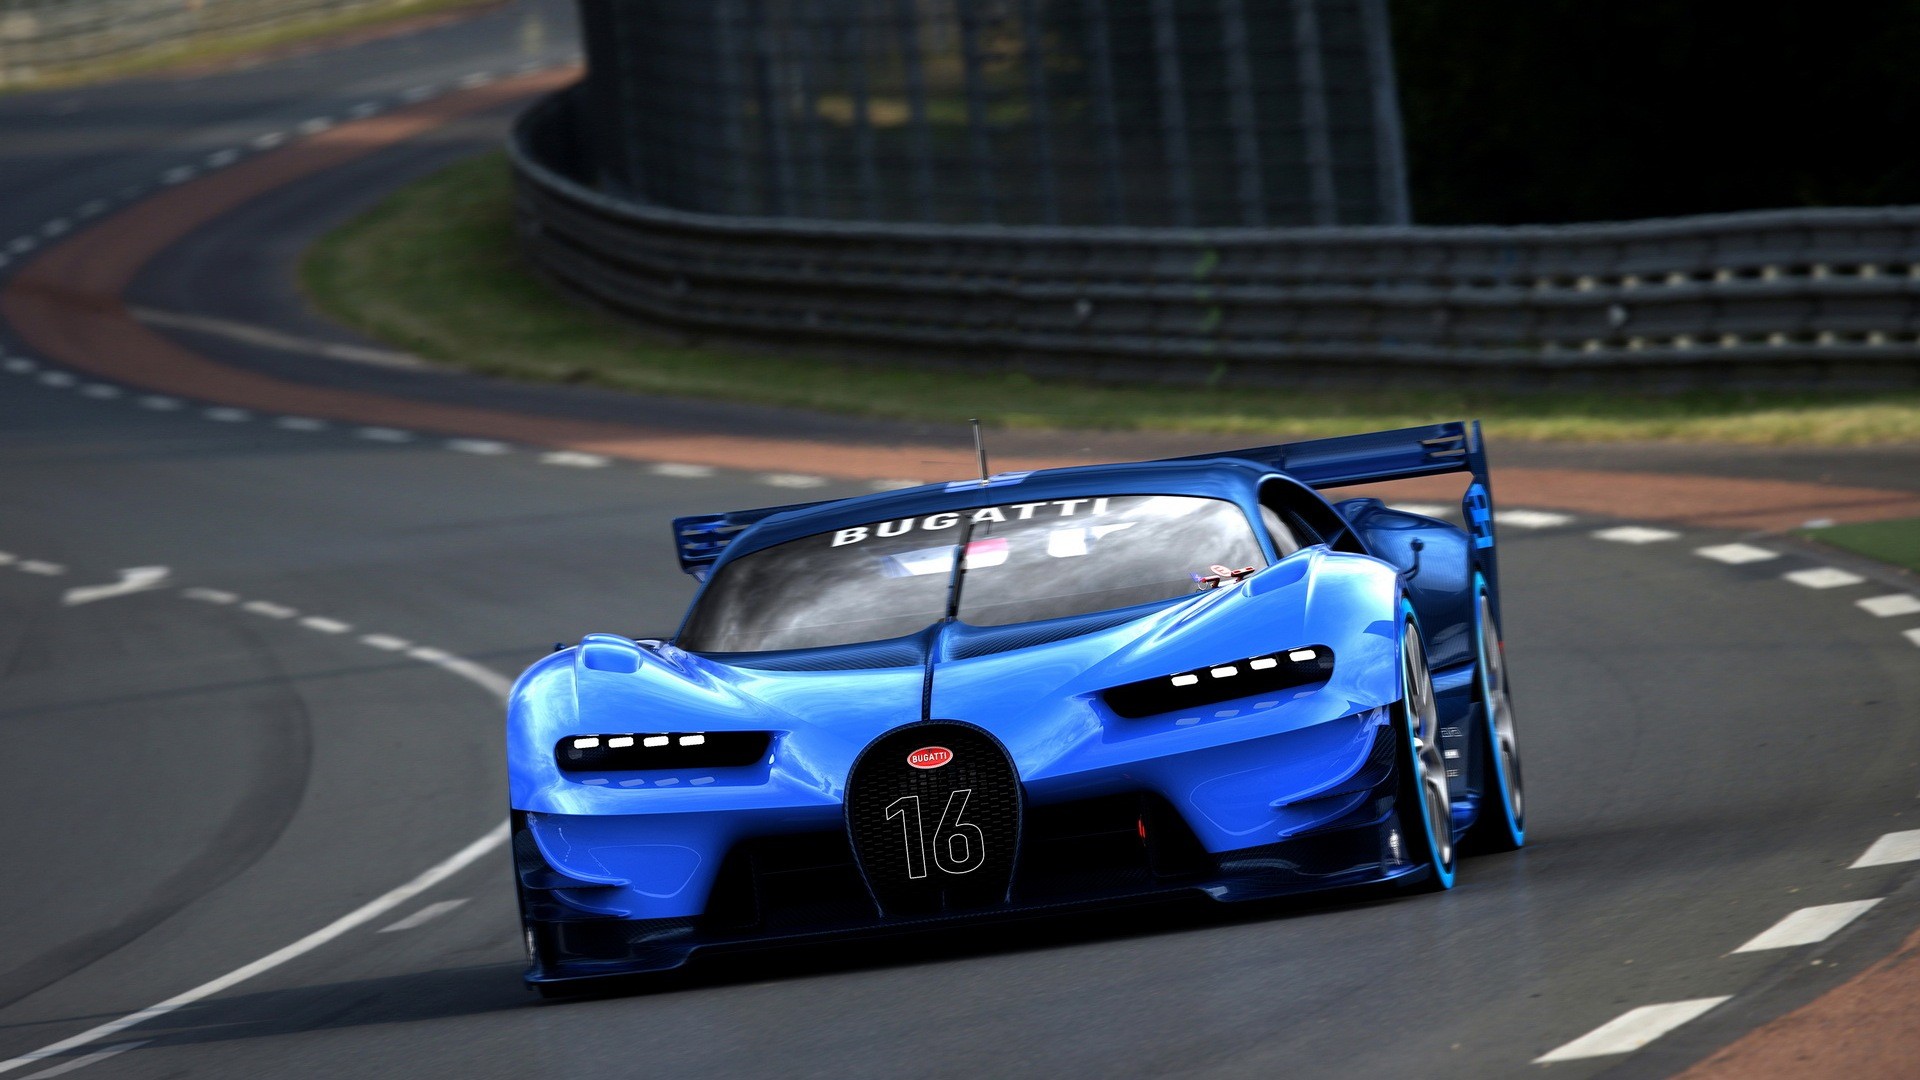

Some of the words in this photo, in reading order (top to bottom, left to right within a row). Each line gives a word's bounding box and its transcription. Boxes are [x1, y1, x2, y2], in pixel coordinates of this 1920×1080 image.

[831, 498, 1109, 547] BUGATTI
[912, 752, 947, 763] BUGATTI
[885, 789, 985, 879] 16
